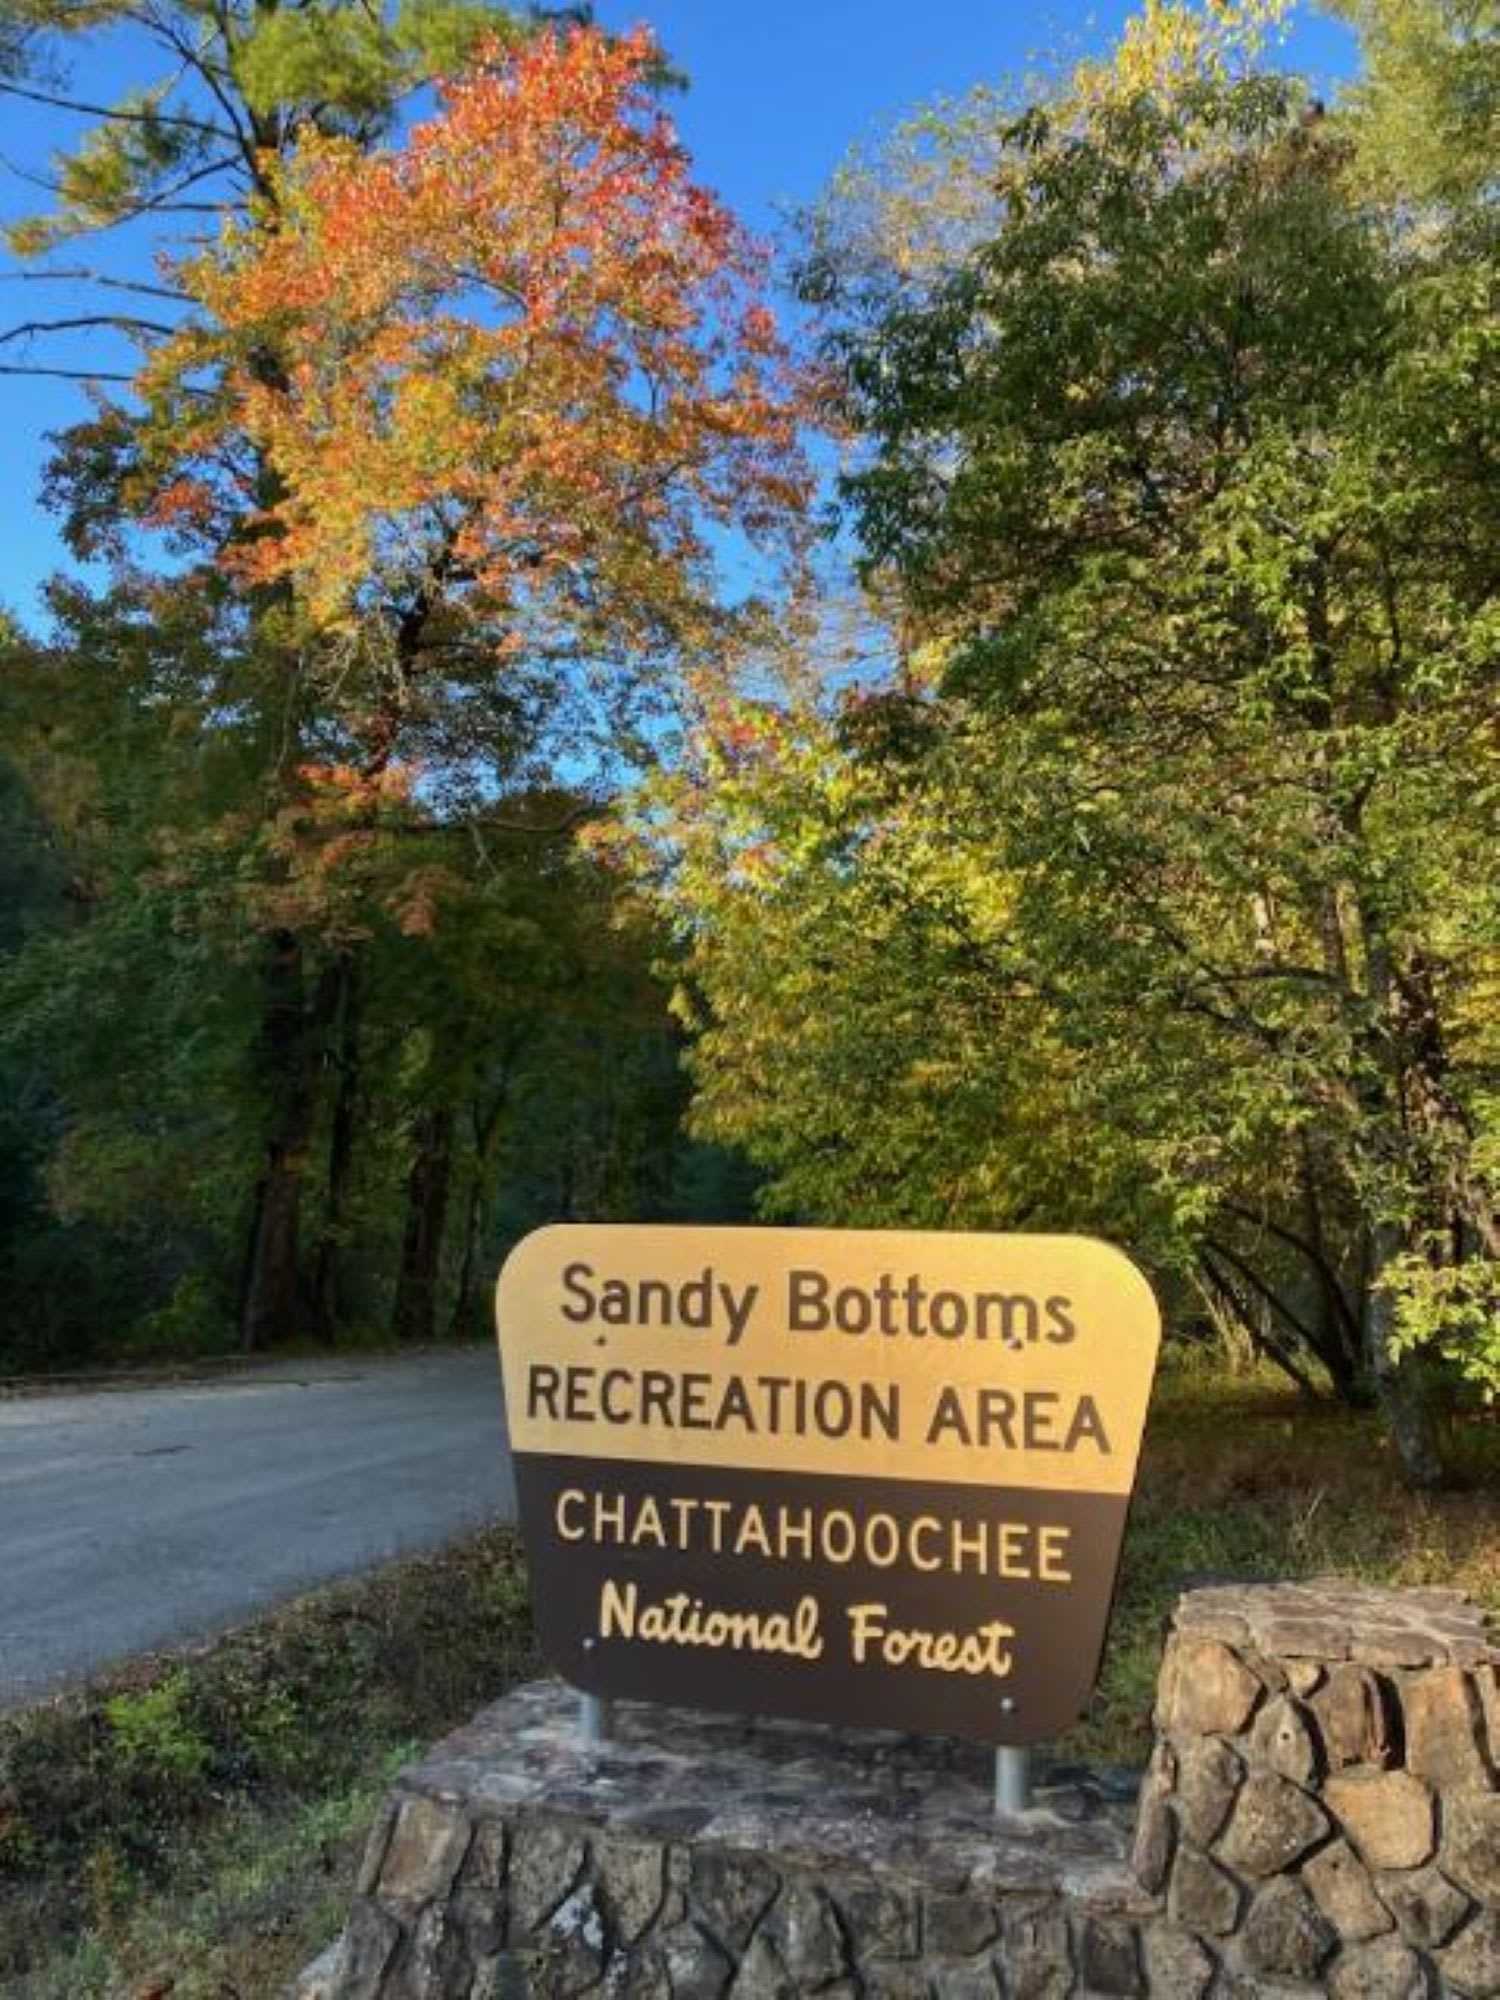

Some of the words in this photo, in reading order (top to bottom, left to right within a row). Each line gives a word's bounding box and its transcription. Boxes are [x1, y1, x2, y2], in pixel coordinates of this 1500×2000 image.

[560, 1262, 759, 1346] Sandy
[788, 1270, 1075, 1343] Bottoms
[526, 1363, 901, 1441] RECREATION
[926, 1386, 1111, 1454] AREA
[556, 1489, 1072, 1582] CHATTAHOOCHEE
[600, 1580, 823, 1659] National
[847, 1604, 1015, 1677] Forest
